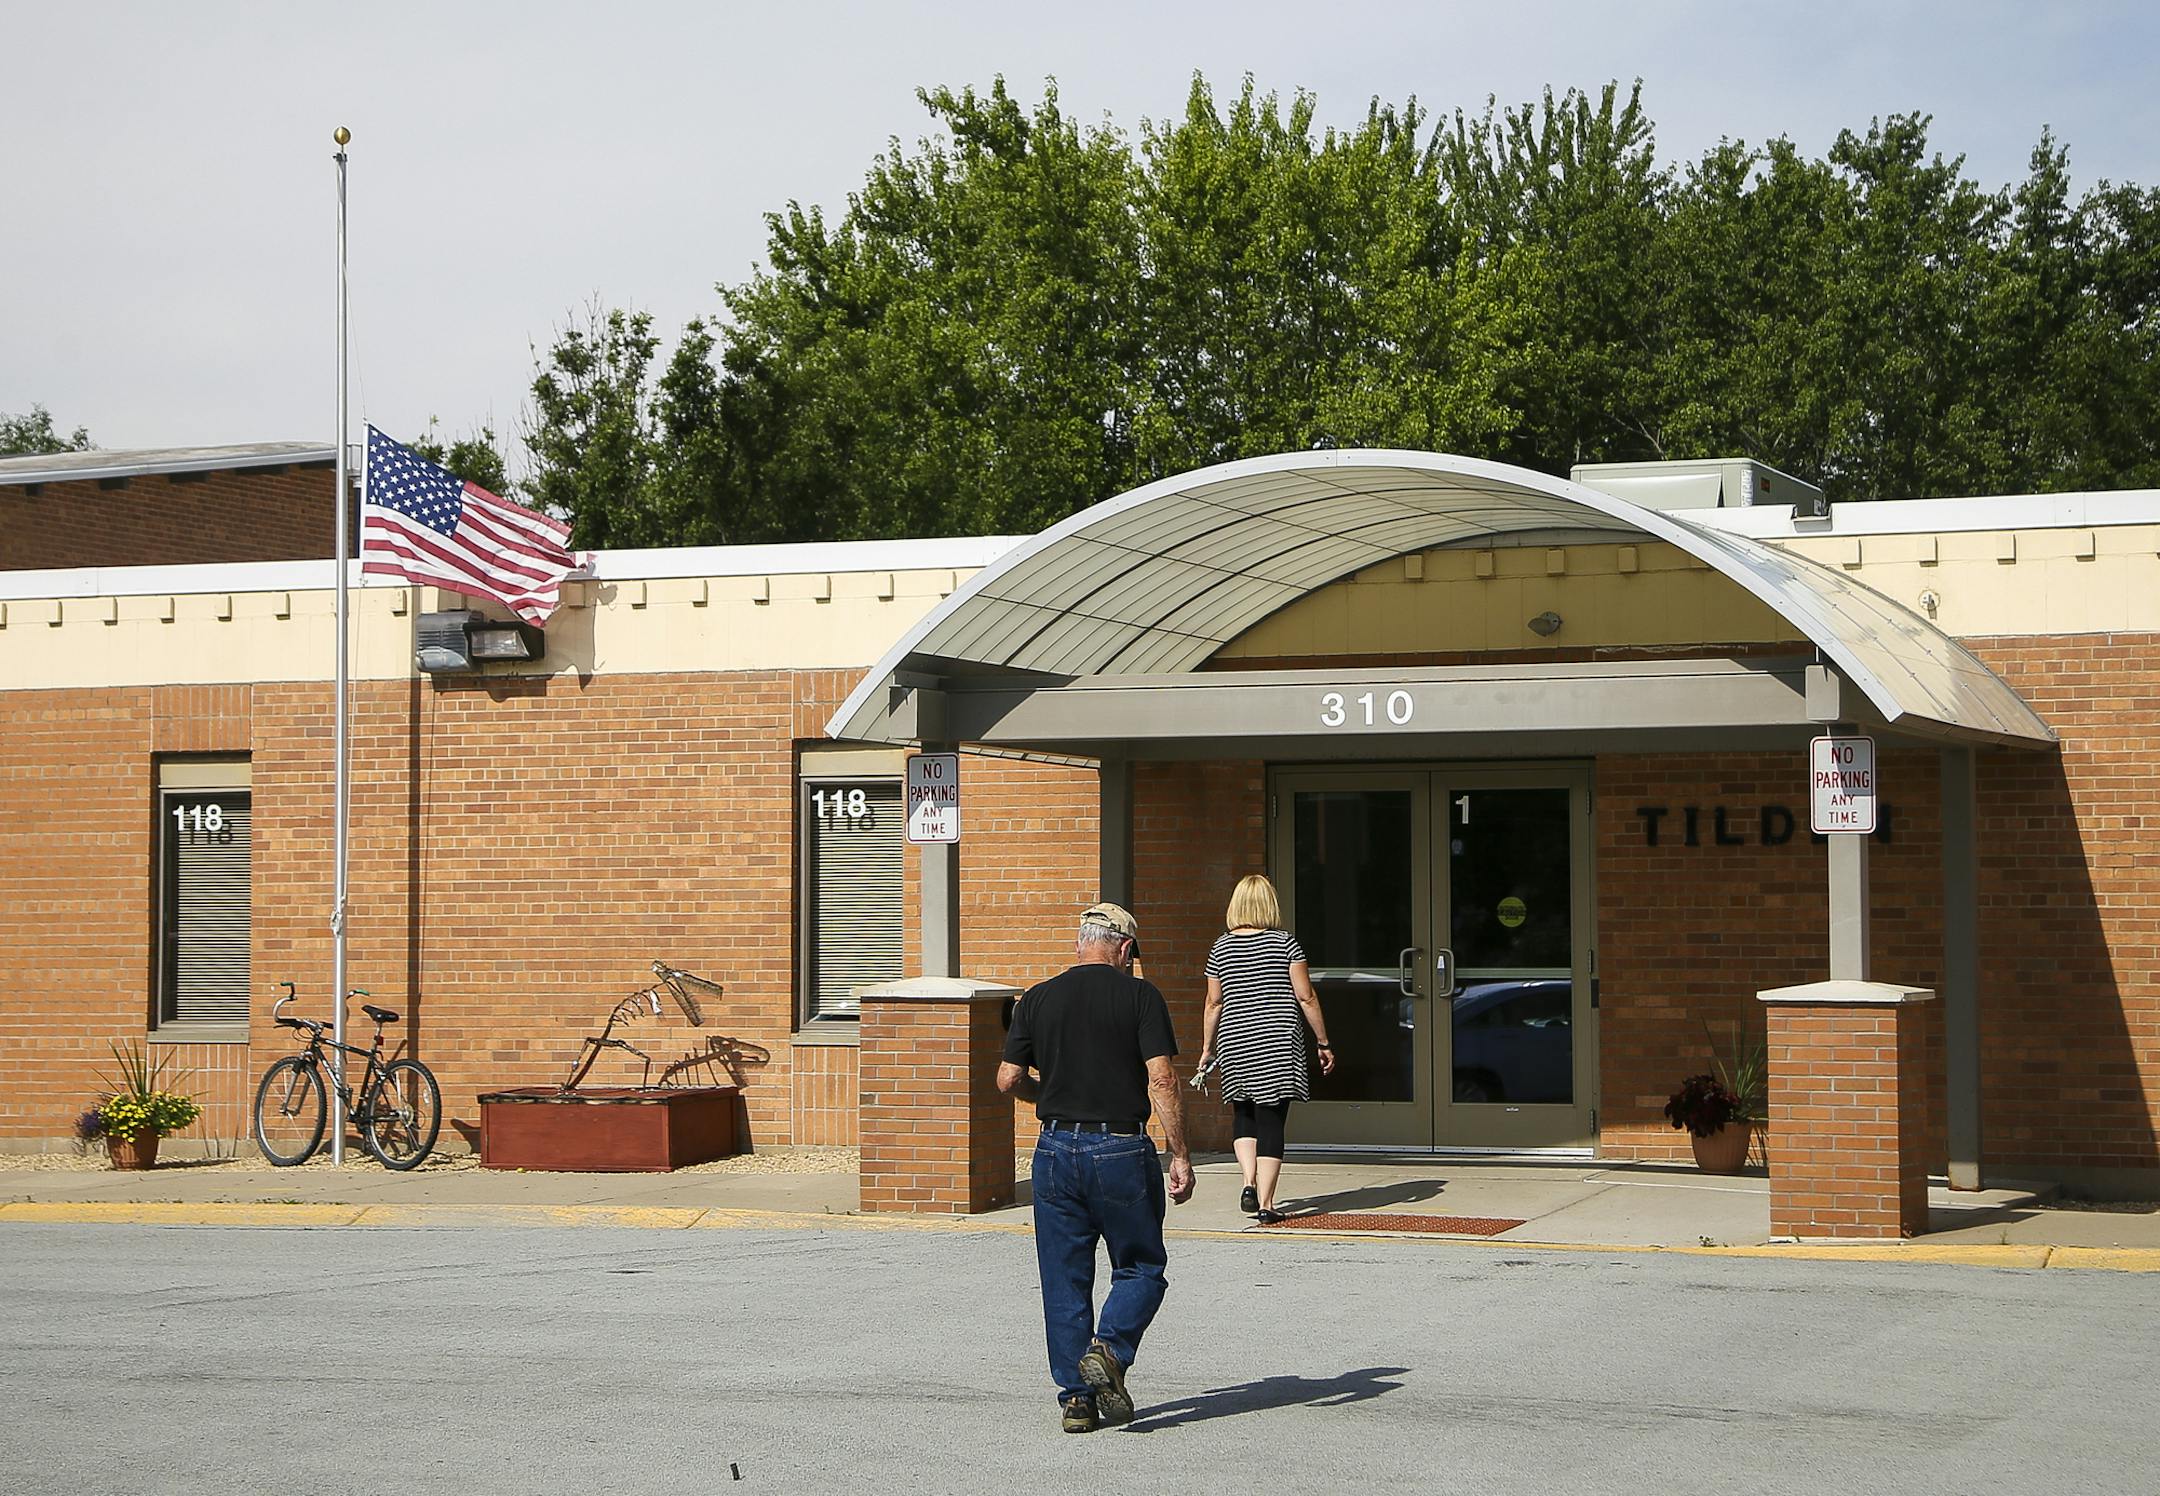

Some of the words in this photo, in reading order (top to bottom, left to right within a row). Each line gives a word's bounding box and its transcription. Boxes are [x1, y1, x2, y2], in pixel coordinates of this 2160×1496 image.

[1320, 689, 1414, 727] 310
[1831, 746, 1853, 764] NO
[923, 762, 942, 779] NO
[1816, 770, 1869, 788] PARKING
[910, 784, 955, 801] PARKING
[1831, 794, 1855, 806] ANY
[812, 788, 866, 818] 118
[923, 806, 943, 818] ANY
[1455, 795, 1470, 824] 1
[172, 804, 222, 831] 118
[1637, 804, 1892, 847] TILD
[1829, 811, 1858, 823] TIME
[921, 823, 945, 834] TIME
